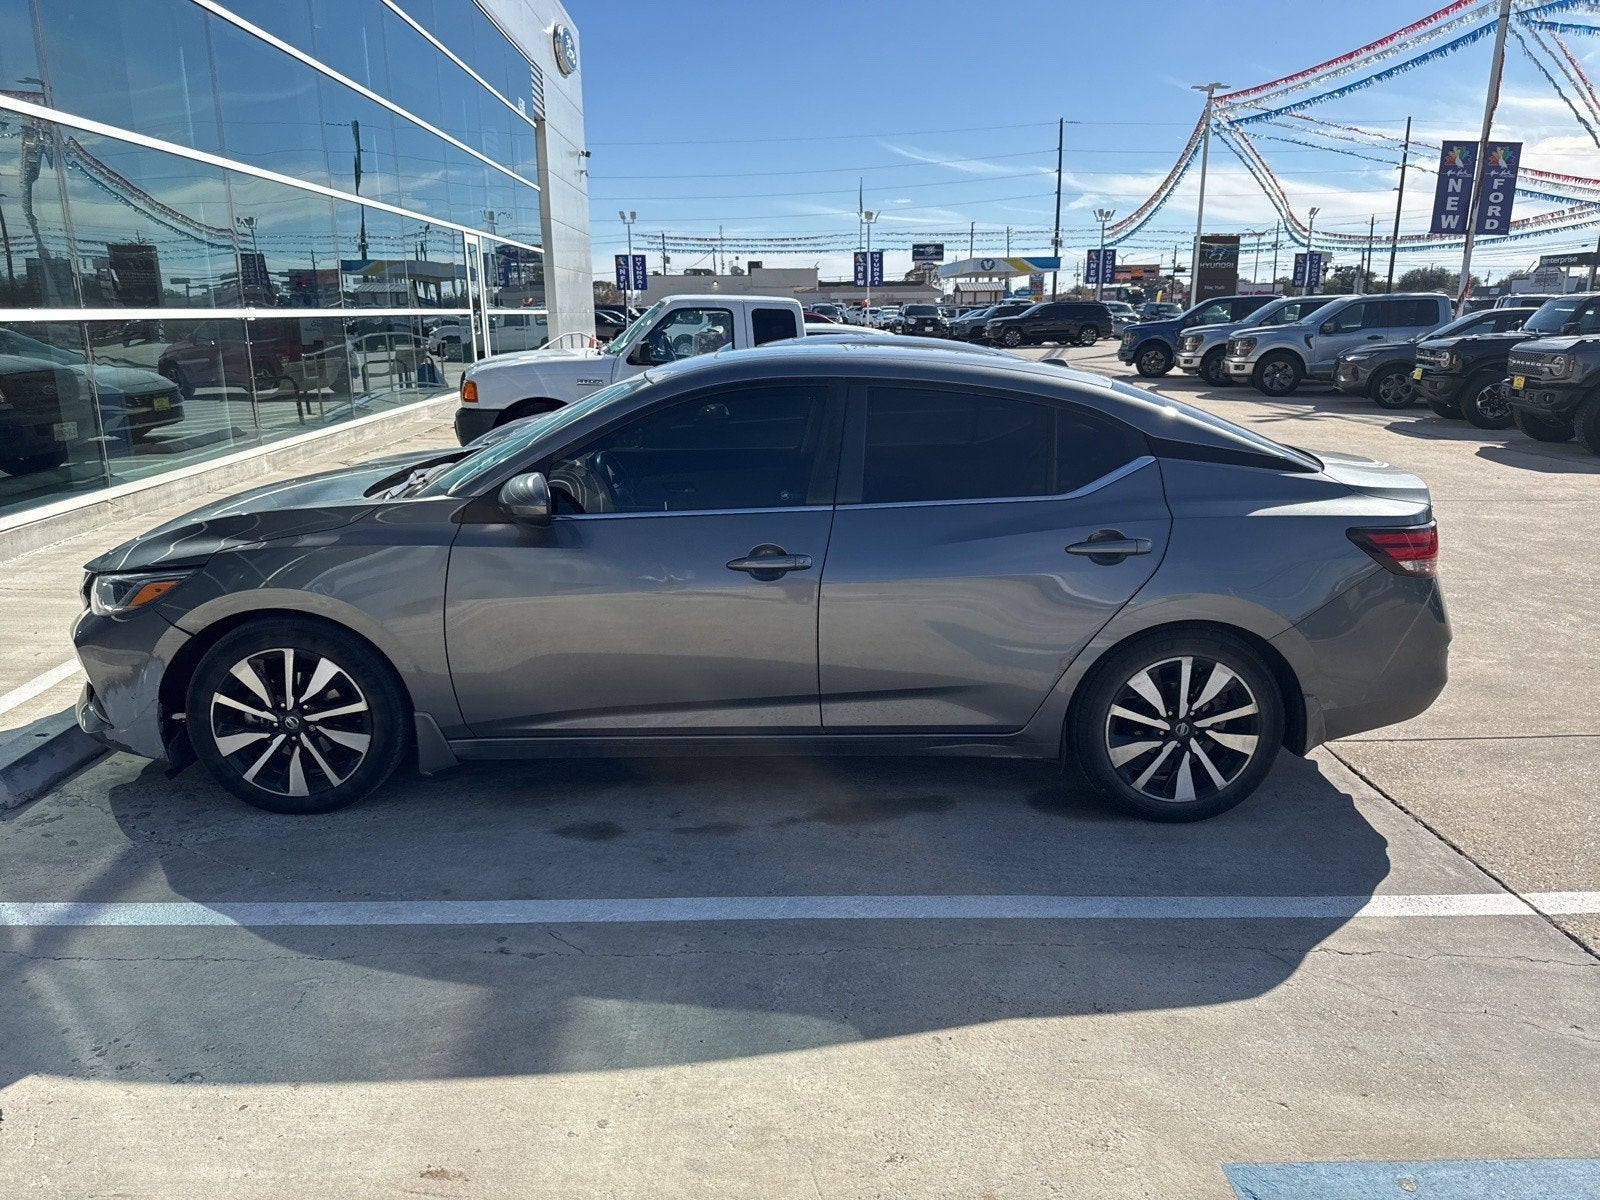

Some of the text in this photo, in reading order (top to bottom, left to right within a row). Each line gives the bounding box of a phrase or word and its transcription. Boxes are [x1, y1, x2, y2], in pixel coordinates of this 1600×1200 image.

[1441, 178, 1462, 229] NEW
[1485, 178, 1505, 230] FORD
[635, 256, 643, 289] HYUNDAI
[856, 265, 865, 286] NEW
[1088, 262, 1097, 283] NEW
[1105, 251, 1113, 282] HYUNDAI
[1310, 255, 1319, 286] HYUNDAI
[1541, 255, 1578, 265] enterprise
[1294, 266, 1304, 286] NEW
